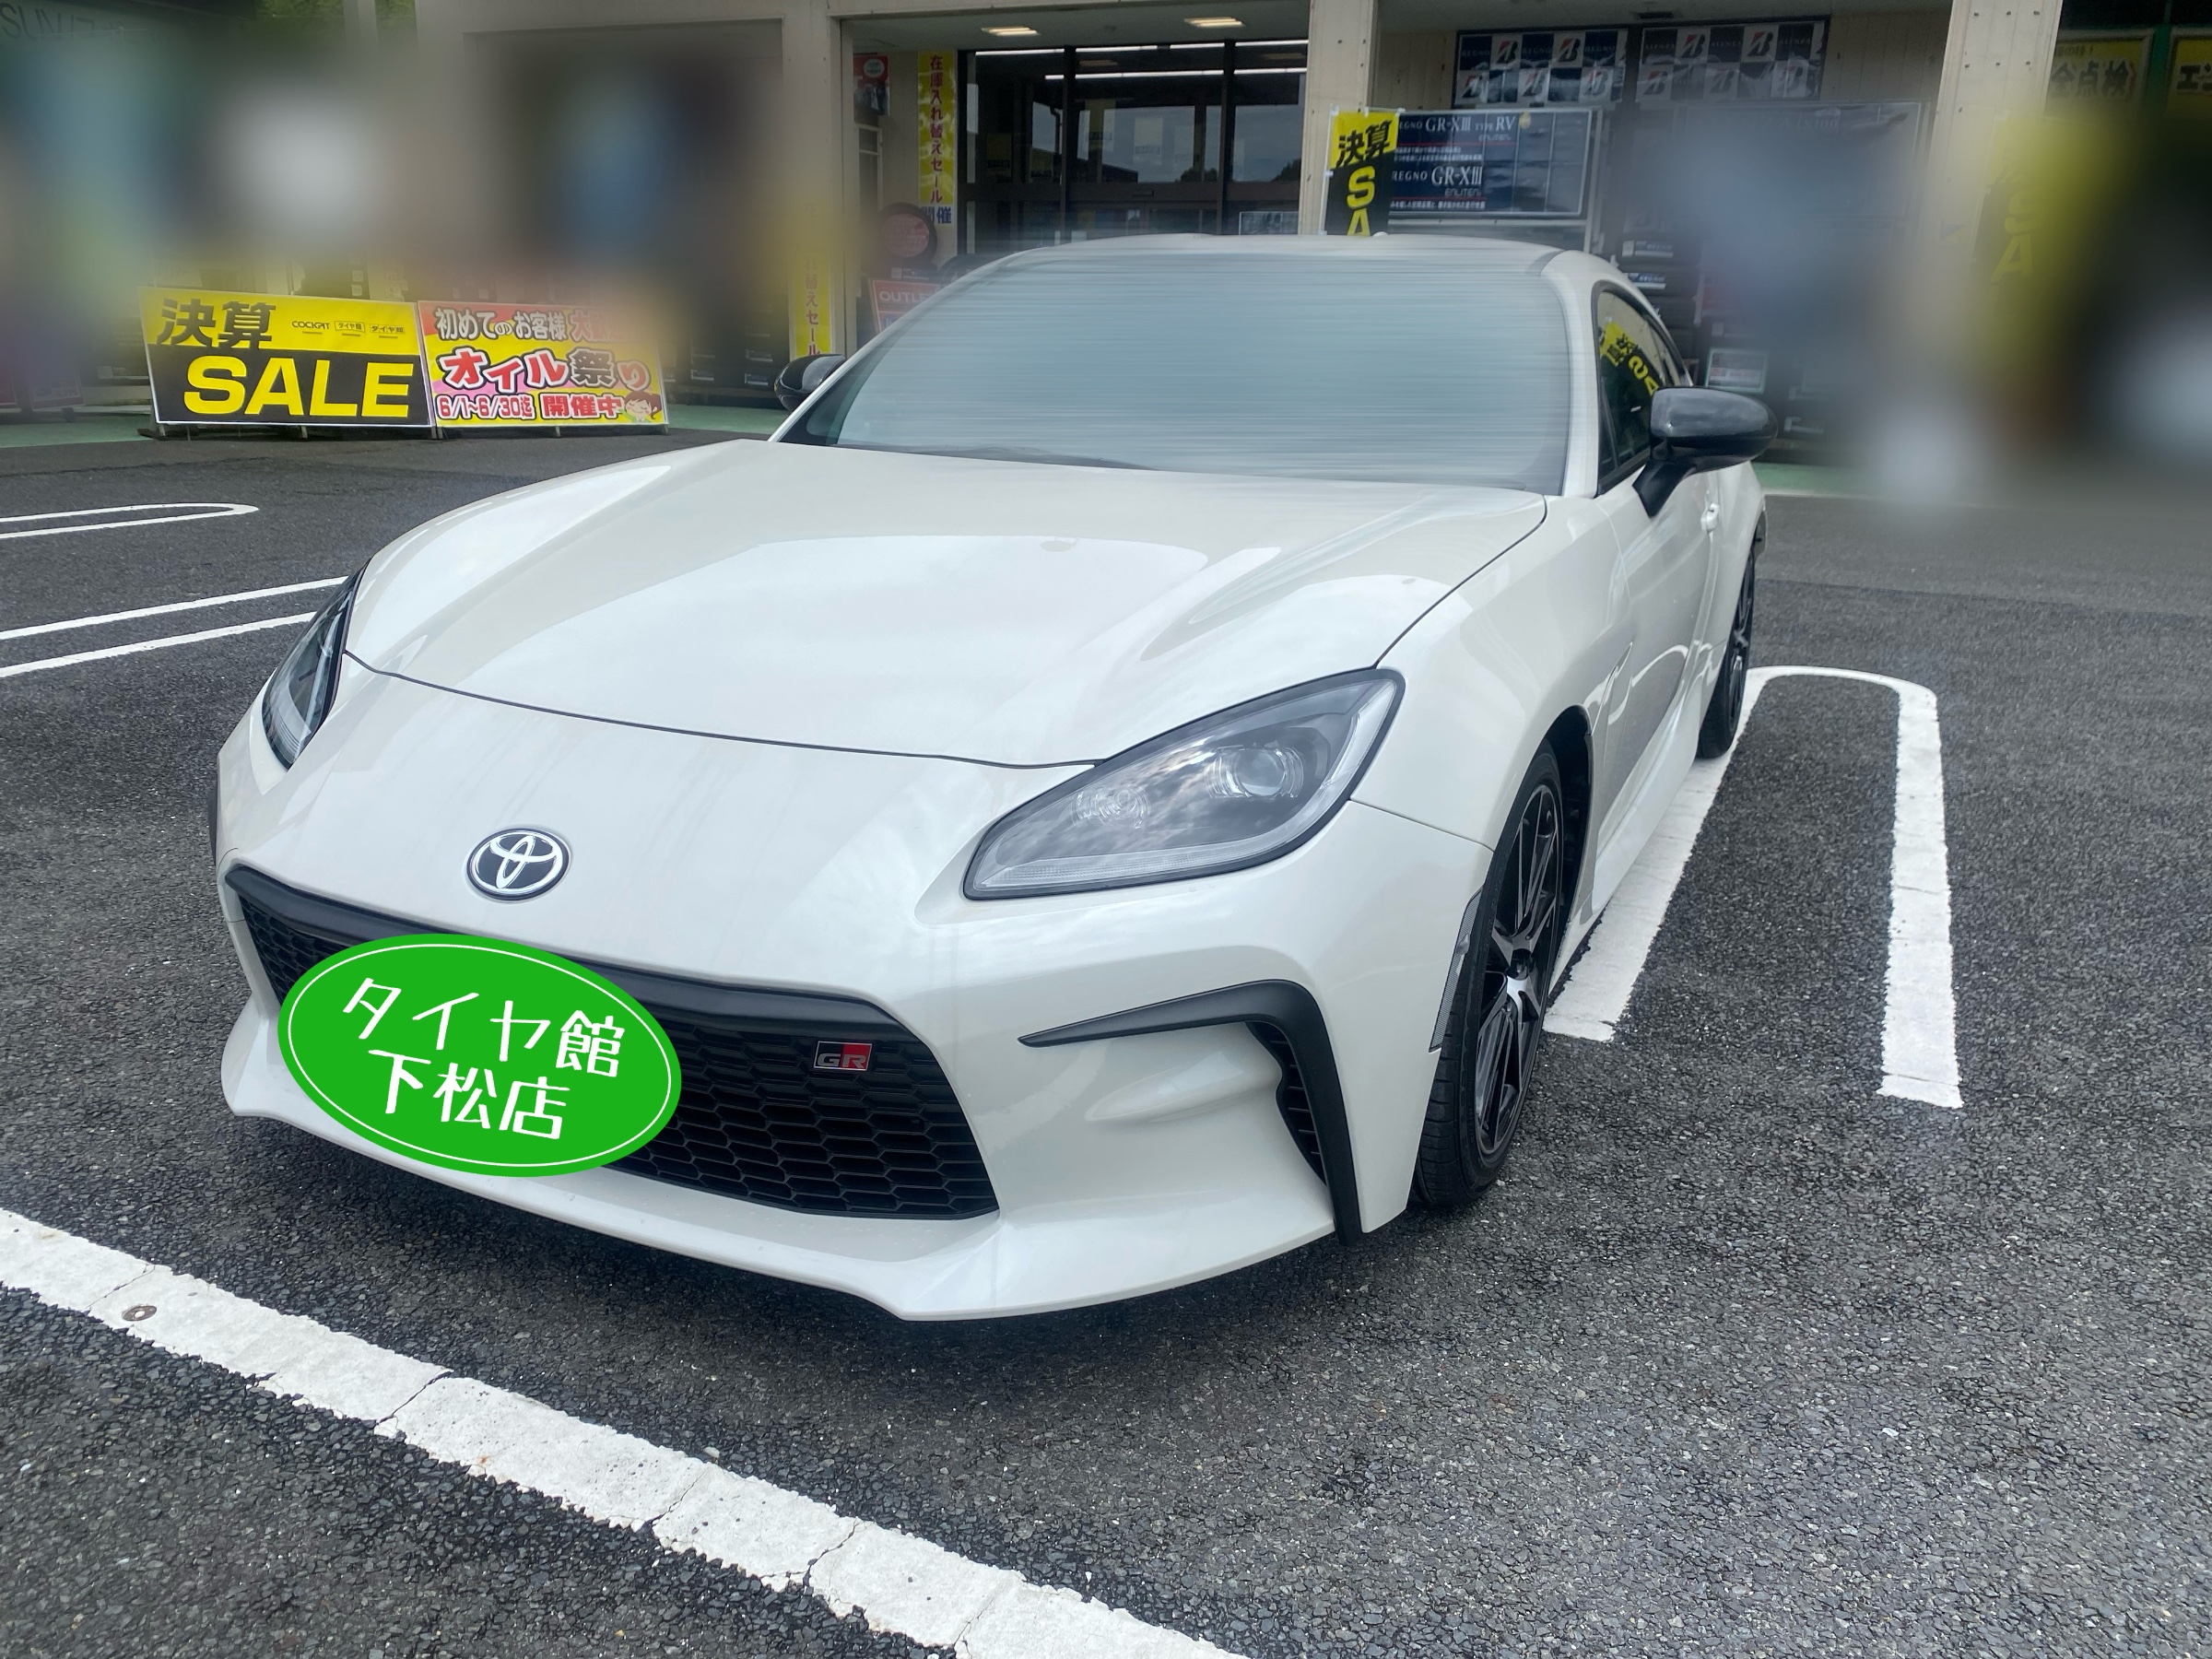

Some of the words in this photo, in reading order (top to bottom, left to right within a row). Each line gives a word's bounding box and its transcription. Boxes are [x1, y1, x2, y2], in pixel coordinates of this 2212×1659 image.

[1495, 115, 1516, 131] RV
[1337, 120, 1393, 168] 決算
[156, 297, 276, 349] 決算
[291, 320, 330, 330] COCKPIT
[183, 355, 415, 418] SALE
[437, 346, 651, 393] オイル祭り
[540, 394, 624, 419] 開催中
[817, 1053, 867, 1069] GR
